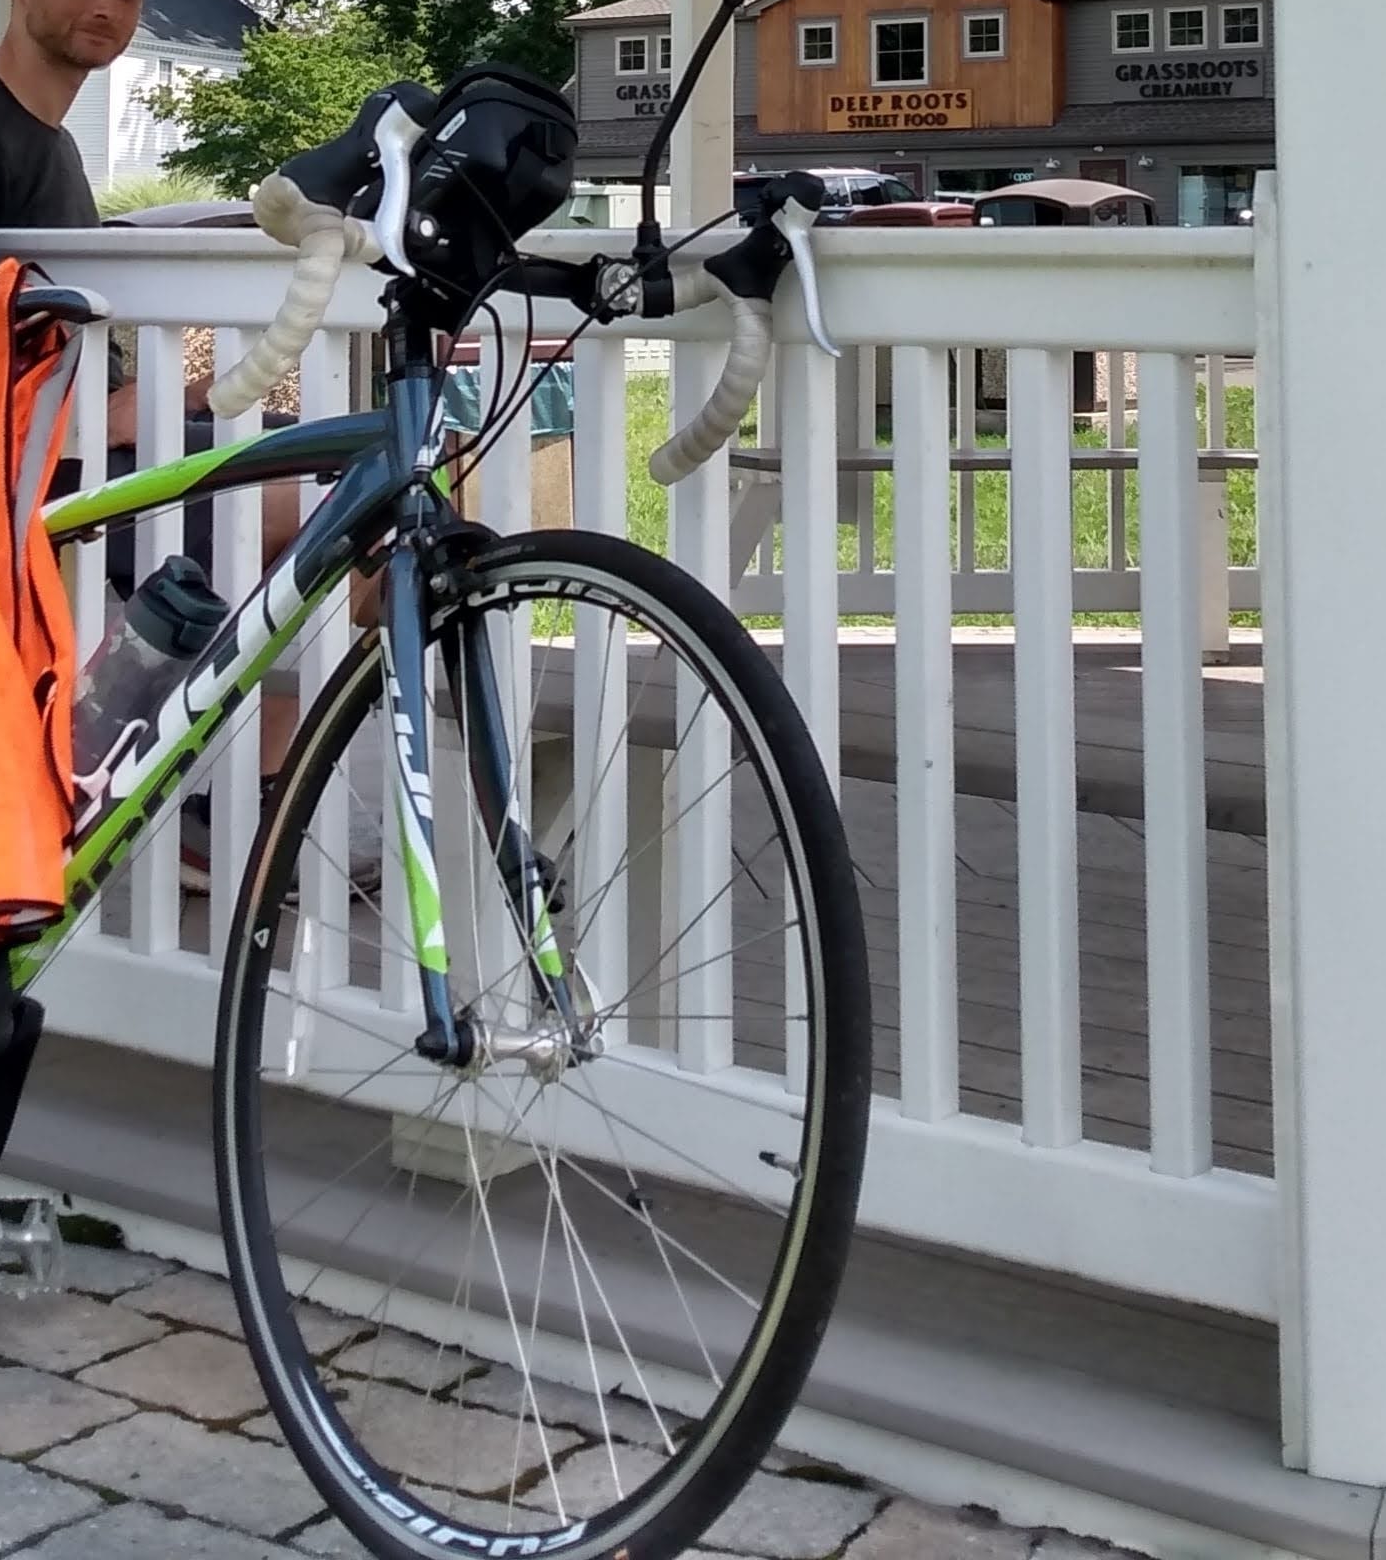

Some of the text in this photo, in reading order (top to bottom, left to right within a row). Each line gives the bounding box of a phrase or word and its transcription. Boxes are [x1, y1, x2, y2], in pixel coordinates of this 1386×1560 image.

[1115, 60, 1259, 82] GRASSROOTS
[616, 83, 671, 100] GRASS
[1139, 82, 1233, 98] CREAMERY
[635, 103, 655, 115] ICE
[830, 93, 967, 112] DEEP ROOTS
[847, 113, 948, 128] STREET FOOD
[74, 553, 305, 836] UJI
[408, 1516, 588, 1557] FUJI
